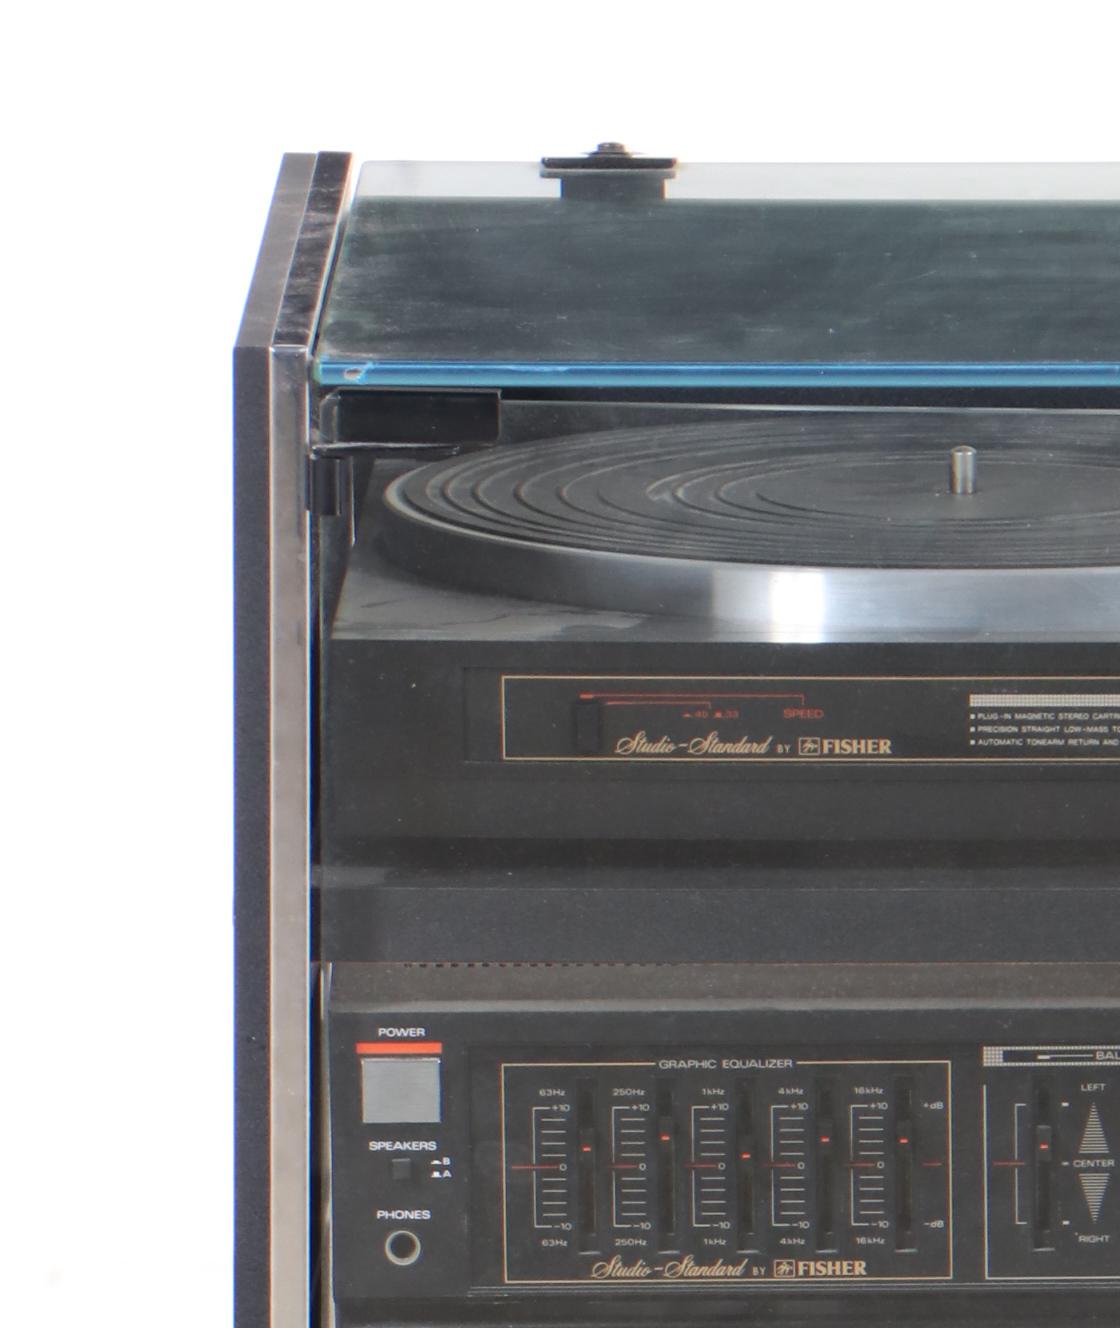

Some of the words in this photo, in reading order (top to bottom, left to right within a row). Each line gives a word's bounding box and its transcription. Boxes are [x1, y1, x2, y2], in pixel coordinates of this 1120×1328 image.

[784, 709, 824, 719] SPEED
[777, 744, 790, 753] BY
[823, 739, 892, 754] FISHER
[378, 1028, 425, 1037] POWER
[659, 1060, 716, 1069] GRAPHIC
[722, 1059, 792, 1068] EQUALIZER
[1081, 1083, 1106, 1091] LEFT
[613, 1088, 645, 1096] 250Hz
[369, 1141, 437, 1150] SPEAKERS
[377, 1210, 430, 1219] PHONES
[1078, 1235, 1110, 1243] RIGHT
[753, 1267, 765, 1276] BY
[796, 1261, 869, 1279] FISHER
